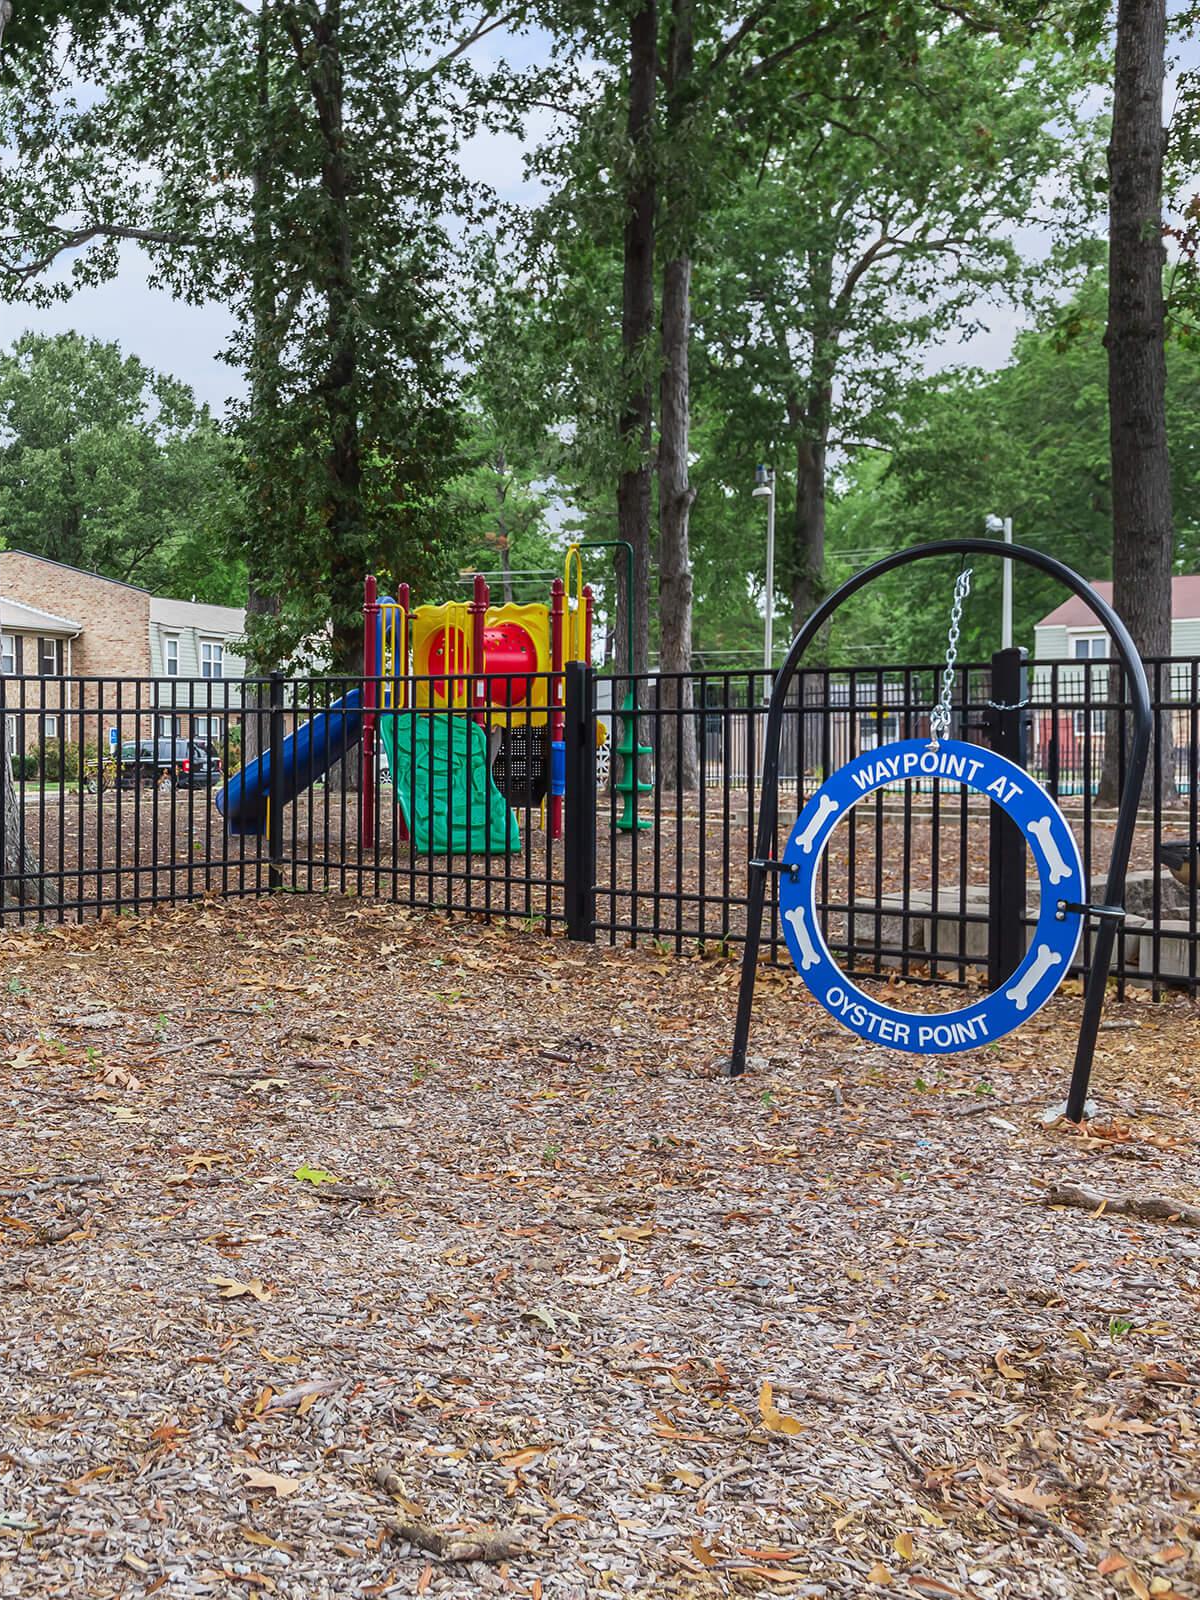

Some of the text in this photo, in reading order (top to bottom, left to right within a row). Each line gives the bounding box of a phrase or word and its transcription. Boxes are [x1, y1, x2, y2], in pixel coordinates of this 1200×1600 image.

[851, 752, 1024, 804] WAYPOINT AT
[826, 986, 990, 1047] OYSTER POINT
